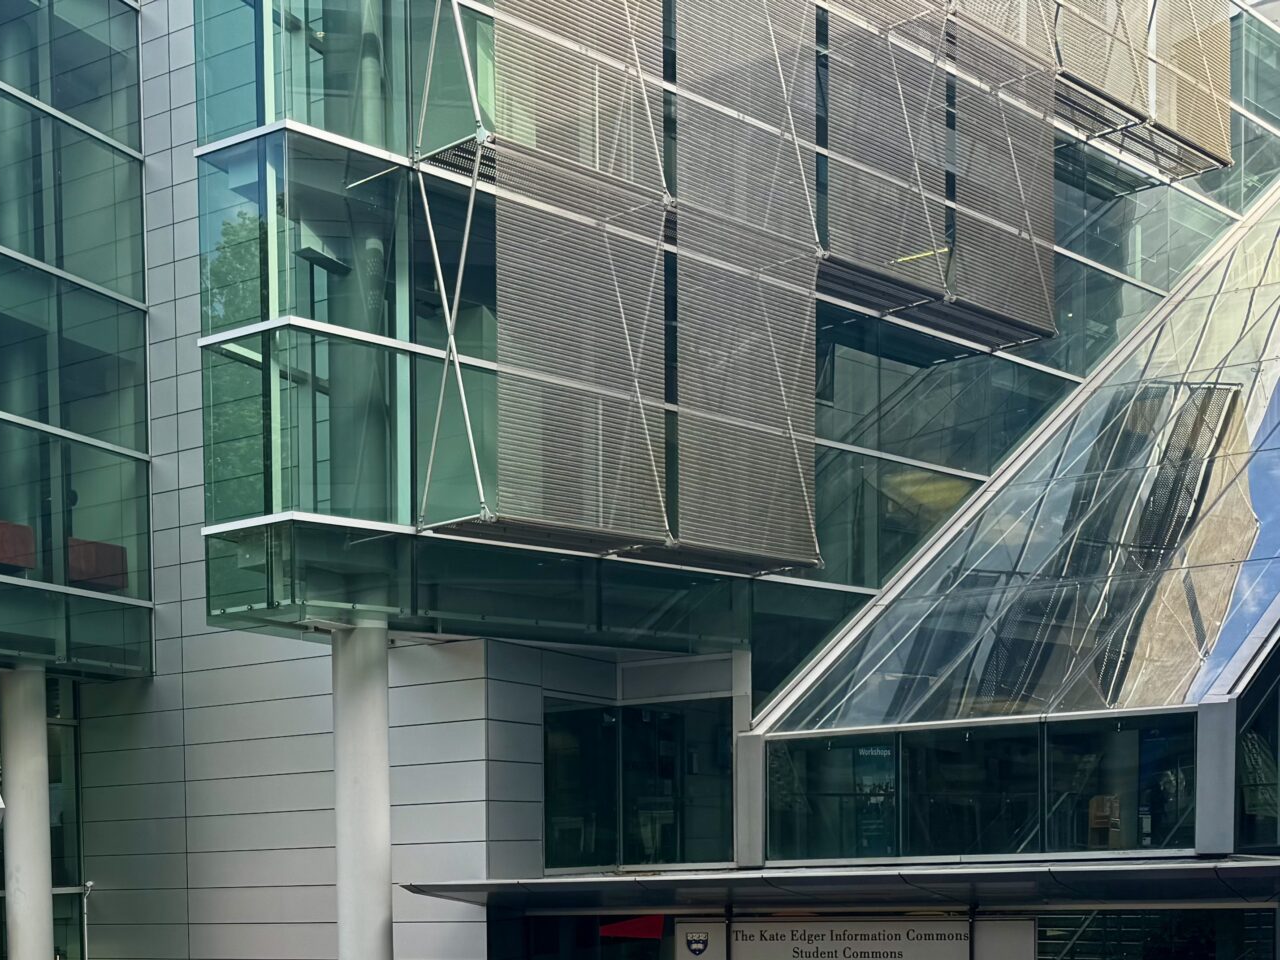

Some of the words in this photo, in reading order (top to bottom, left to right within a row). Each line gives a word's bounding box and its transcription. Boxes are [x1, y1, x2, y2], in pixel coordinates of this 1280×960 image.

[858, 746, 891, 758] Workshops
[733, 929, 755, 942] The
[759, 929, 786, 942] Kate
[790, 929, 826, 944] Edger
[830, 929, 901, 942] Information
[906, 929, 969, 942] Commons
[792, 946, 838, 959] Student
[843, 946, 903, 959] Commons
